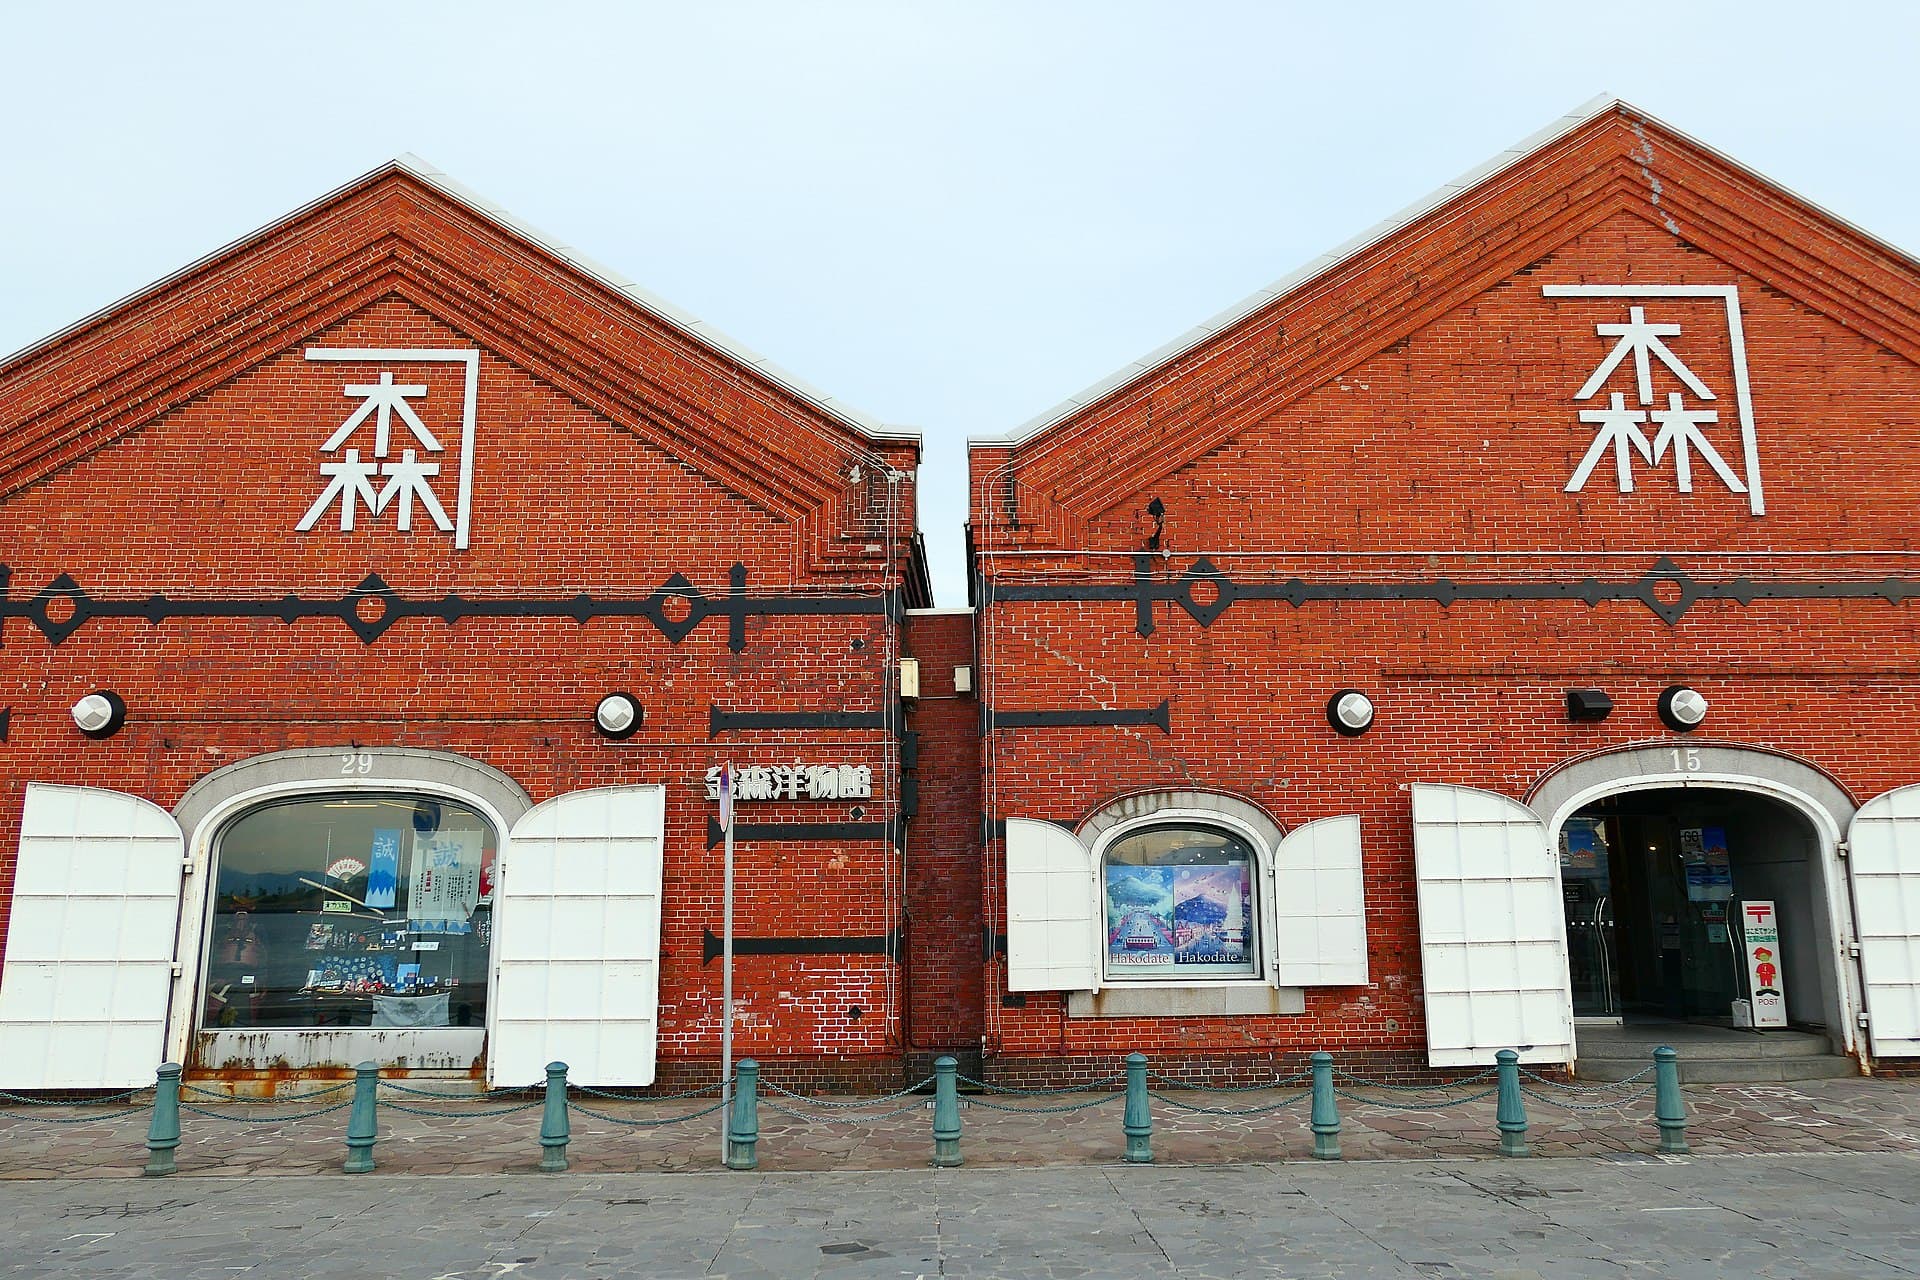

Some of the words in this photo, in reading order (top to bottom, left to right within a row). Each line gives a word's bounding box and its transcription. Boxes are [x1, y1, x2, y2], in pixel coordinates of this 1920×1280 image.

[341, 753, 373, 774] 29
[1670, 749, 1701, 771] 15
[704, 765, 872, 800] 金森洋物館
[373, 836, 396, 861] 誠
[432, 841, 463, 869] 誠
[1110, 952, 1169, 964] Hakodate
[1178, 951, 1239, 963] Hakodate
[1758, 998, 1778, 1006] POST
